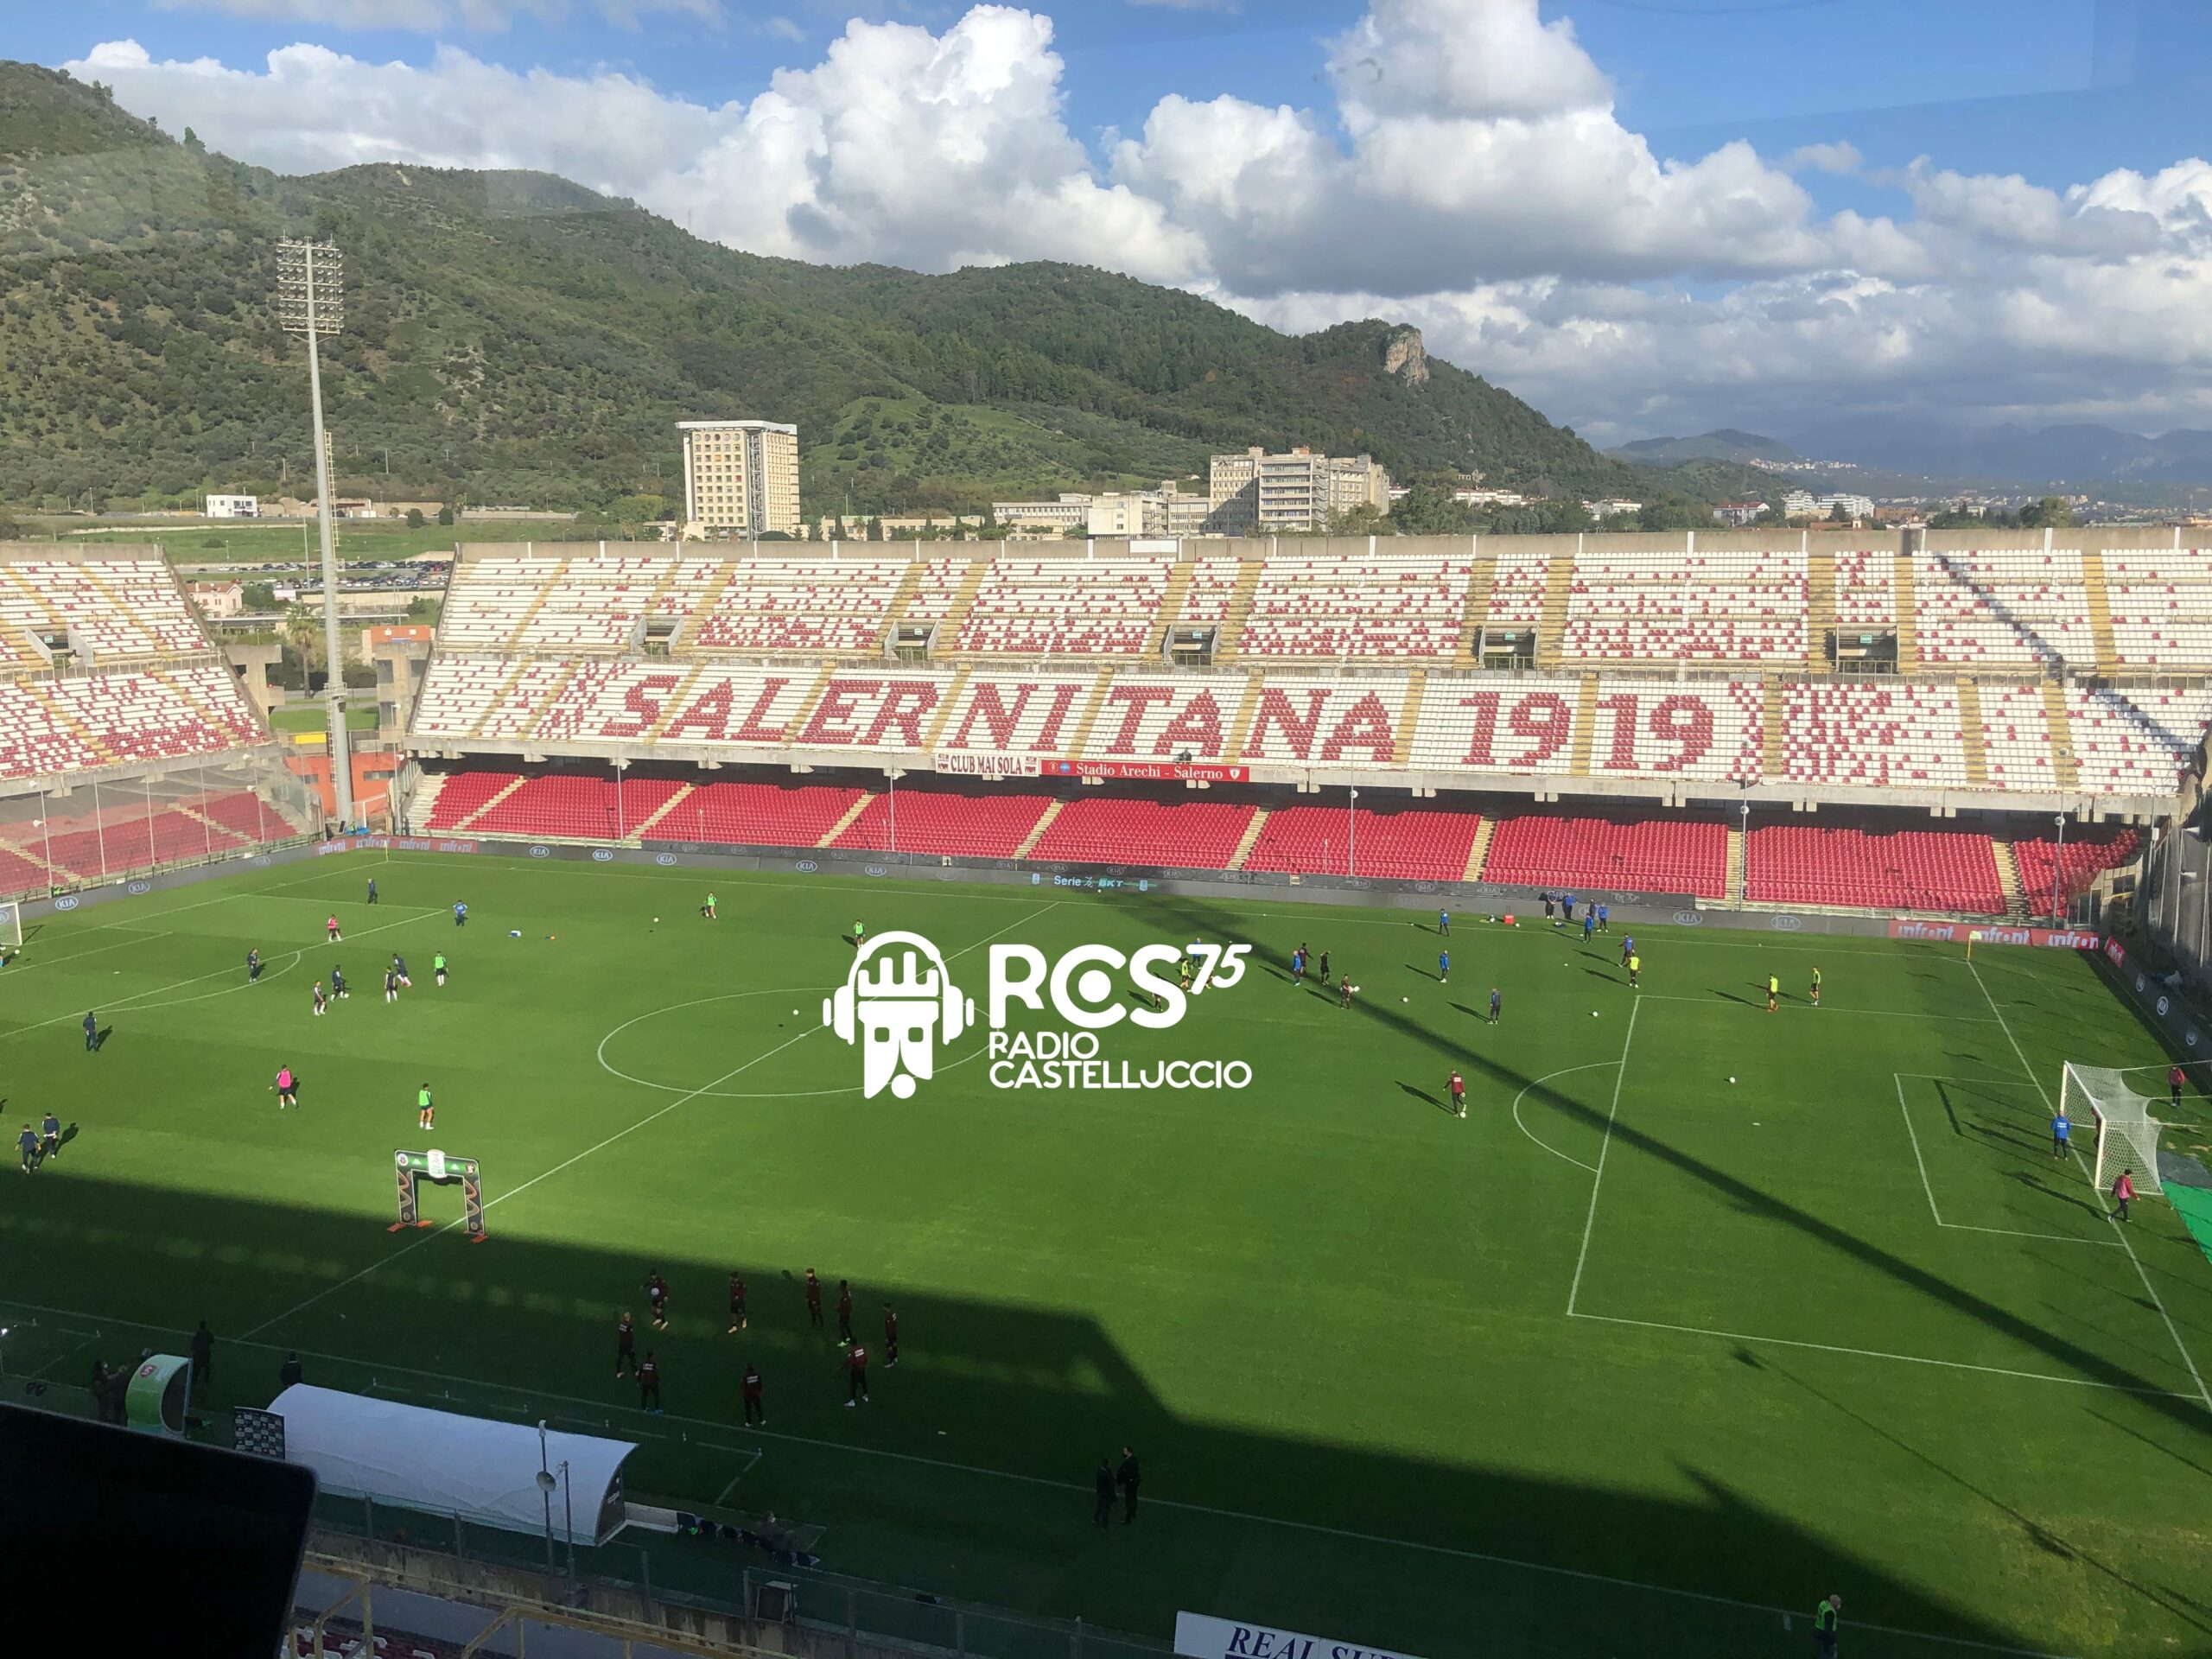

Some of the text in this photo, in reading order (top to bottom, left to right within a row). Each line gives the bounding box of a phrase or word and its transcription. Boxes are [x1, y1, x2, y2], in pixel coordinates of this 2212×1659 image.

[599, 676, 1713, 772] SALERNITANA 1919
[950, 755, 1022, 774] CLUB MAI SOLA
[1076, 763, 1115, 776] Stadio
[1119, 764, 1160, 778] Arechi
[1173, 766, 1224, 779] Salerno
[531, 847, 549, 856] KIA
[594, 850, 612, 860] KIA
[658, 854, 676, 864] KIA
[798, 861, 816, 871] KIA
[867, 866, 885, 875] KIA
[1054, 875, 1081, 887] Serie
[130, 882, 149, 893] KIA
[57, 899, 76, 909] KIA
[1676, 912, 1699, 924] KIA
[1774, 917, 1797, 929] KIA
